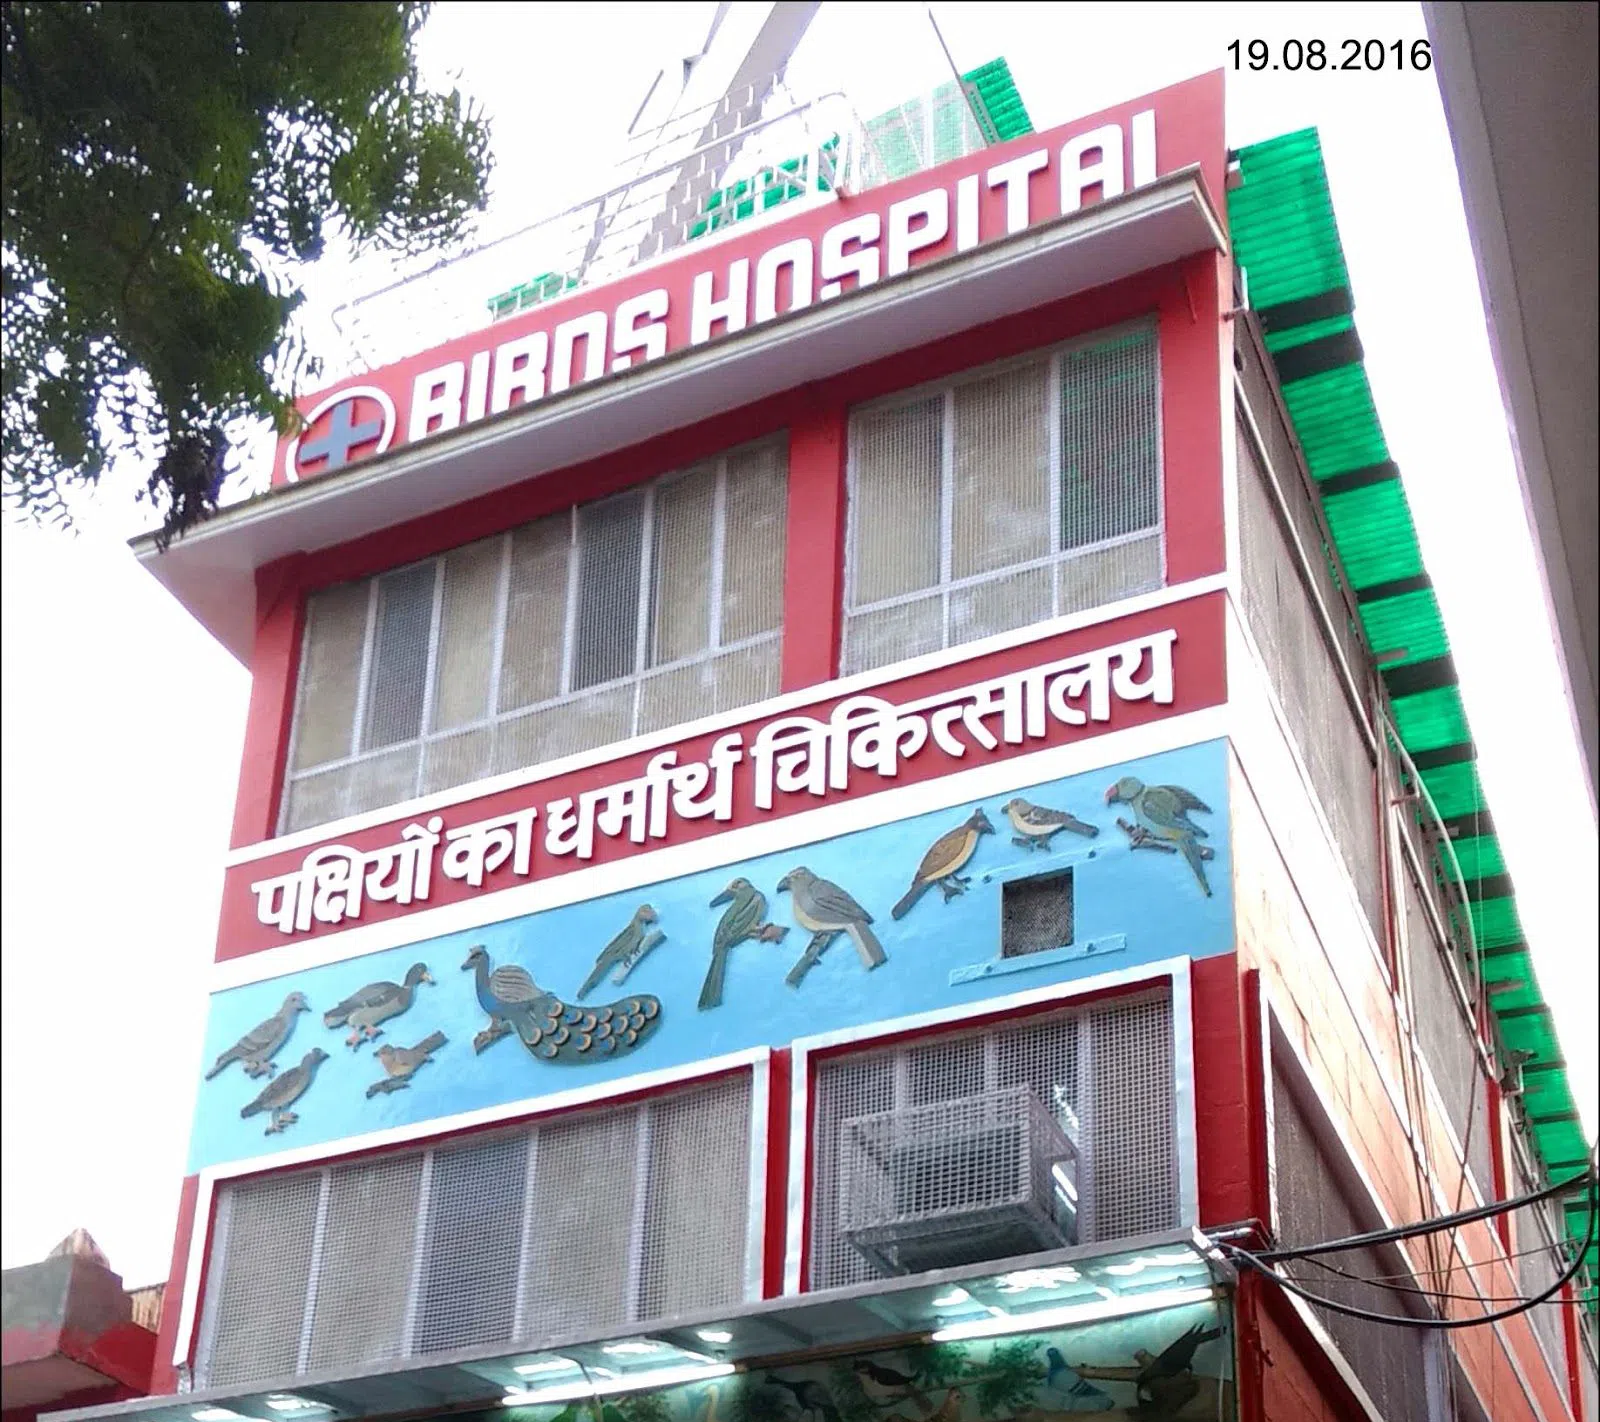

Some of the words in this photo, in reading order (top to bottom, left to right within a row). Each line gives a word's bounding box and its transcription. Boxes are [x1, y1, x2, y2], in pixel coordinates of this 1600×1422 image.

[251, 816, 443, 935] पक्षियों
[441, 806, 538, 887] का
[546, 733, 747, 859] धर्मार्थ
[754, 628, 1179, 797] चिकित्सालय
